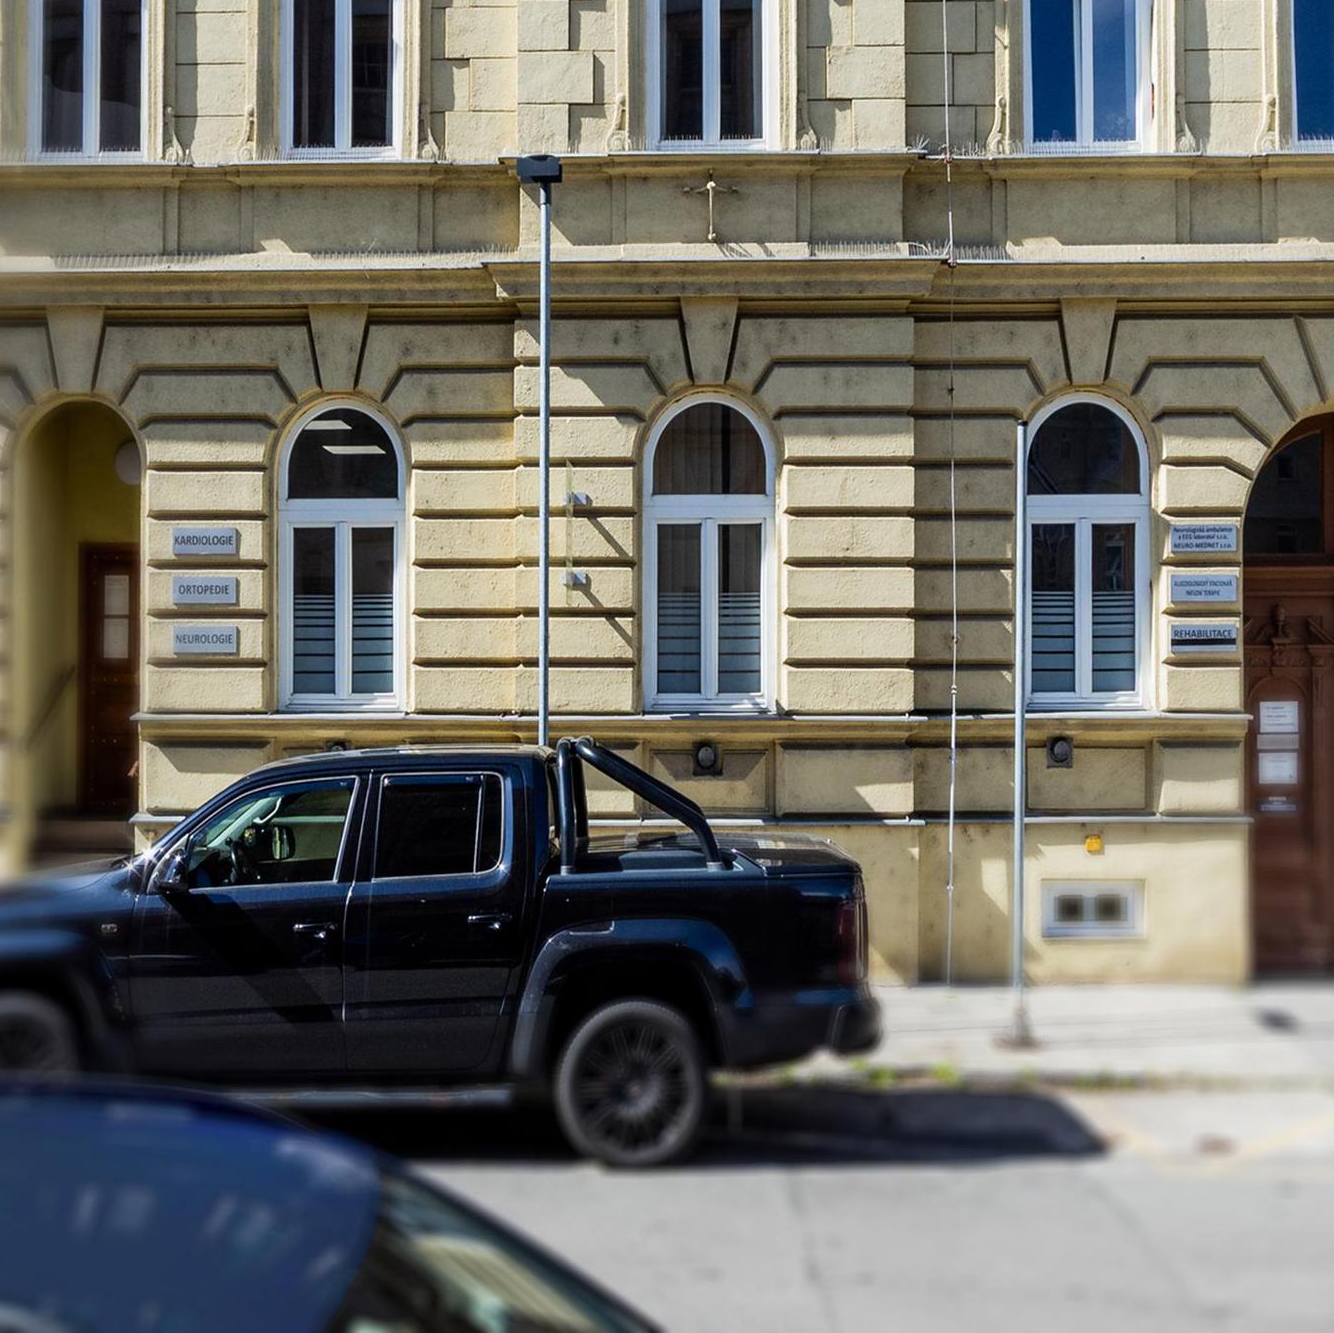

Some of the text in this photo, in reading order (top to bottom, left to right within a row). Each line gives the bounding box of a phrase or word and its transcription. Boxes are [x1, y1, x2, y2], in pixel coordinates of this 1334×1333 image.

[174, 535, 234, 546] KARDIOLOGIE
[178, 584, 230, 595] ORTOPEDIE
[1174, 629, 1233, 638] REHABILITACE
[175, 634, 233, 644] NEUROLOGIE
